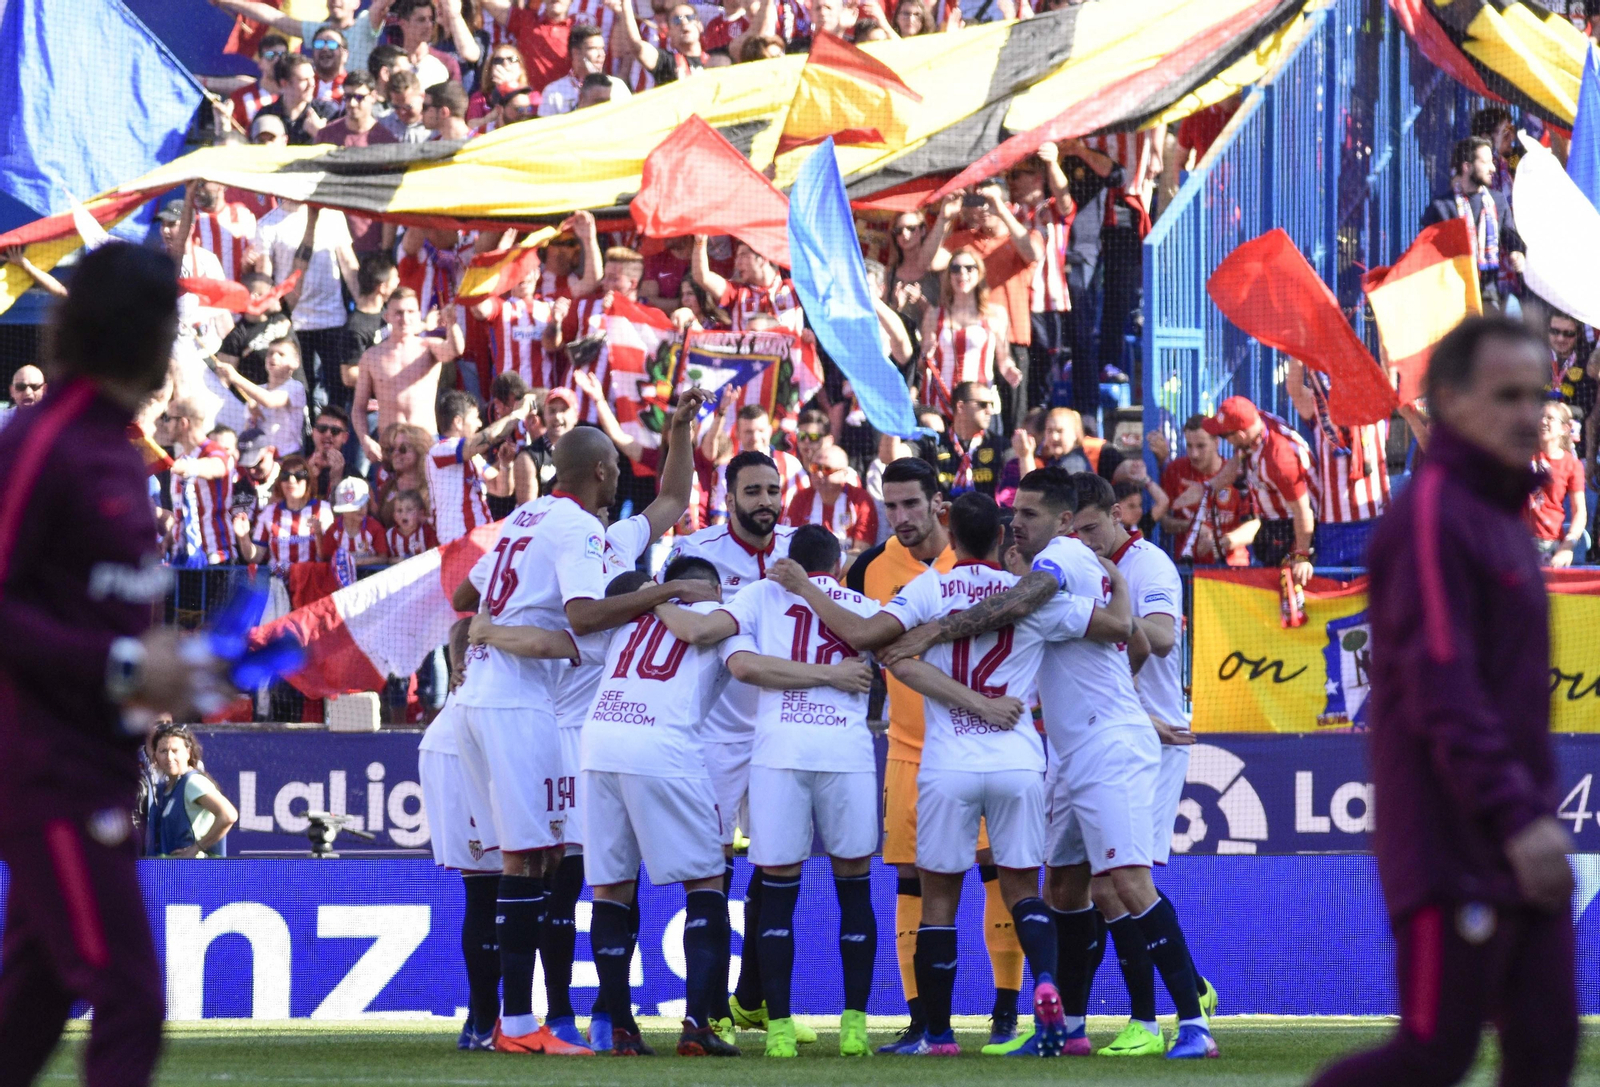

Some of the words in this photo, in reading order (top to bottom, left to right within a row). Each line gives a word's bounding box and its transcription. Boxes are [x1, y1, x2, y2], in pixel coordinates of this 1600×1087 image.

[487, 536, 533, 616] 15
[610, 612, 690, 682] 10
[948, 608, 1015, 699] 12
[1218, 651, 1308, 684] on
[600, 690, 625, 701] SEE
[782, 690, 809, 702] SEE
[596, 701, 648, 714] PUERTO
[781, 702, 836, 714] PUERTO
[591, 711, 656, 727] RICO.COM
[780, 712, 847, 727] RICO.COM
